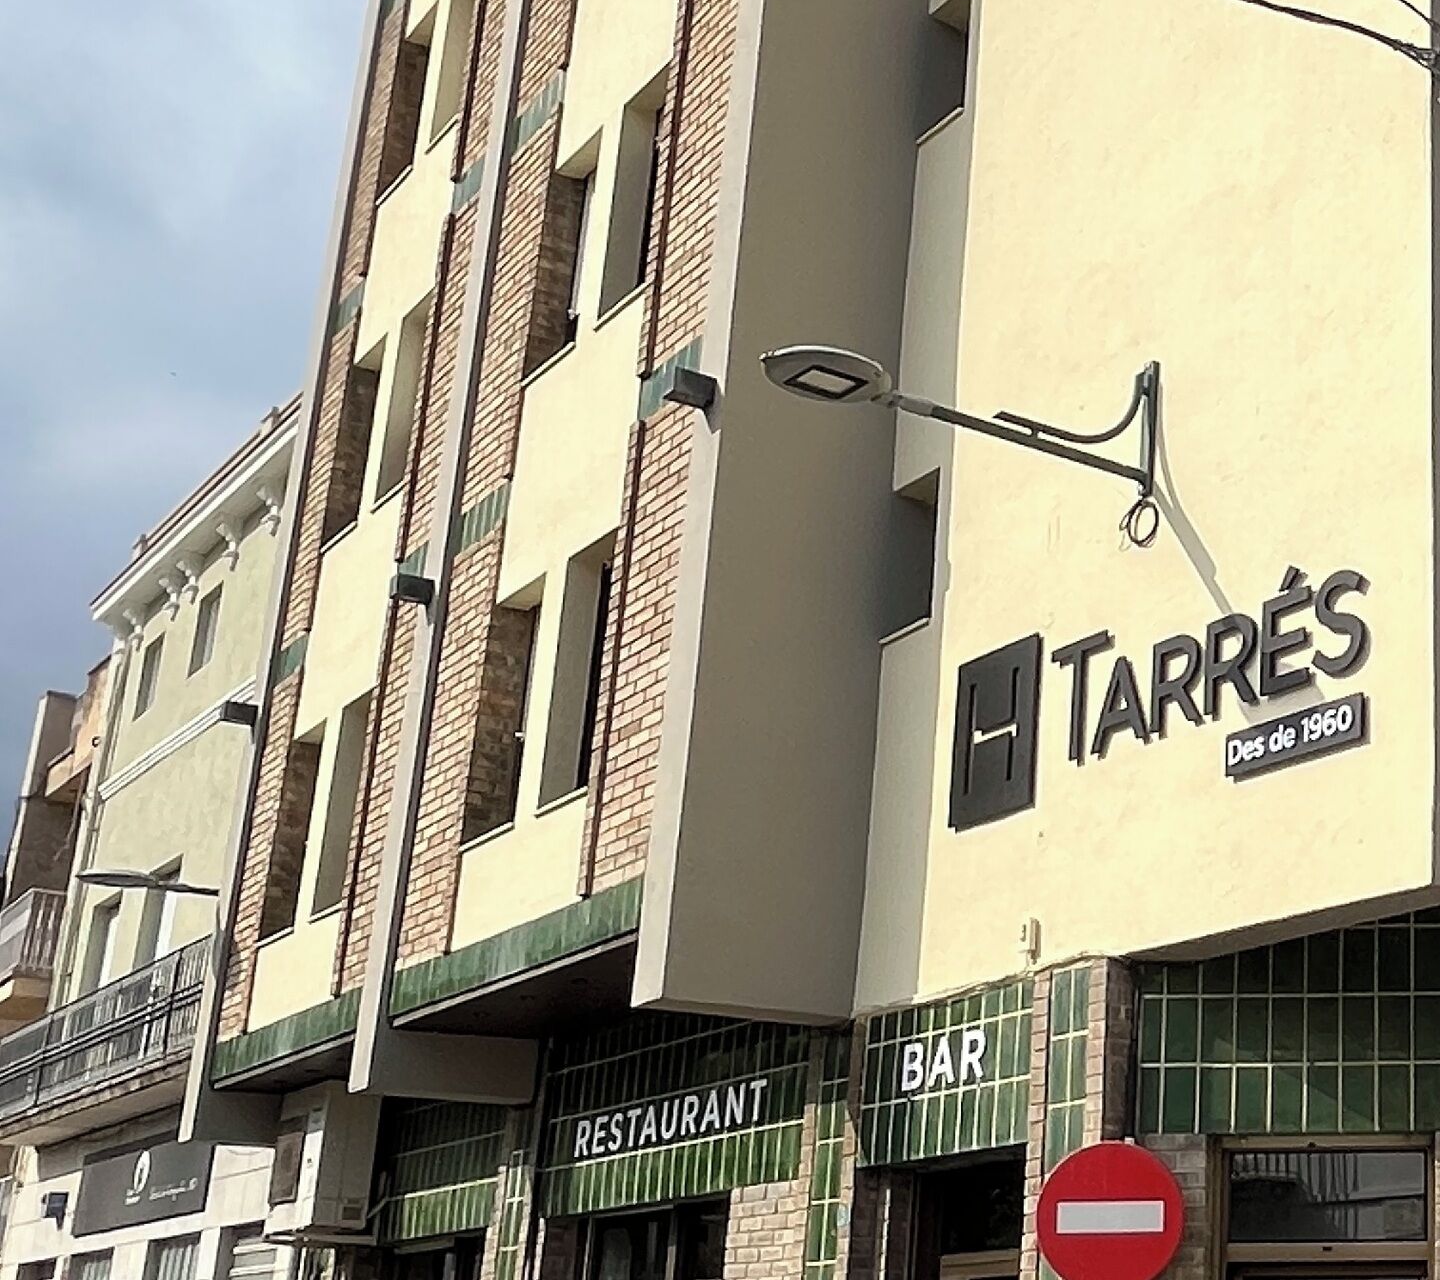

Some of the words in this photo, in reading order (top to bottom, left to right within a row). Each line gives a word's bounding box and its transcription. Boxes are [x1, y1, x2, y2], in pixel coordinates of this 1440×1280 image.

[1051, 565, 1371, 766] TARRÉS
[1227, 735, 1265, 767] Des
[1268, 723, 1297, 753] de
[1300, 704, 1353, 743] 1960
[901, 1029, 987, 1092] BAR
[573, 1078, 768, 1158] RESTAURANT
